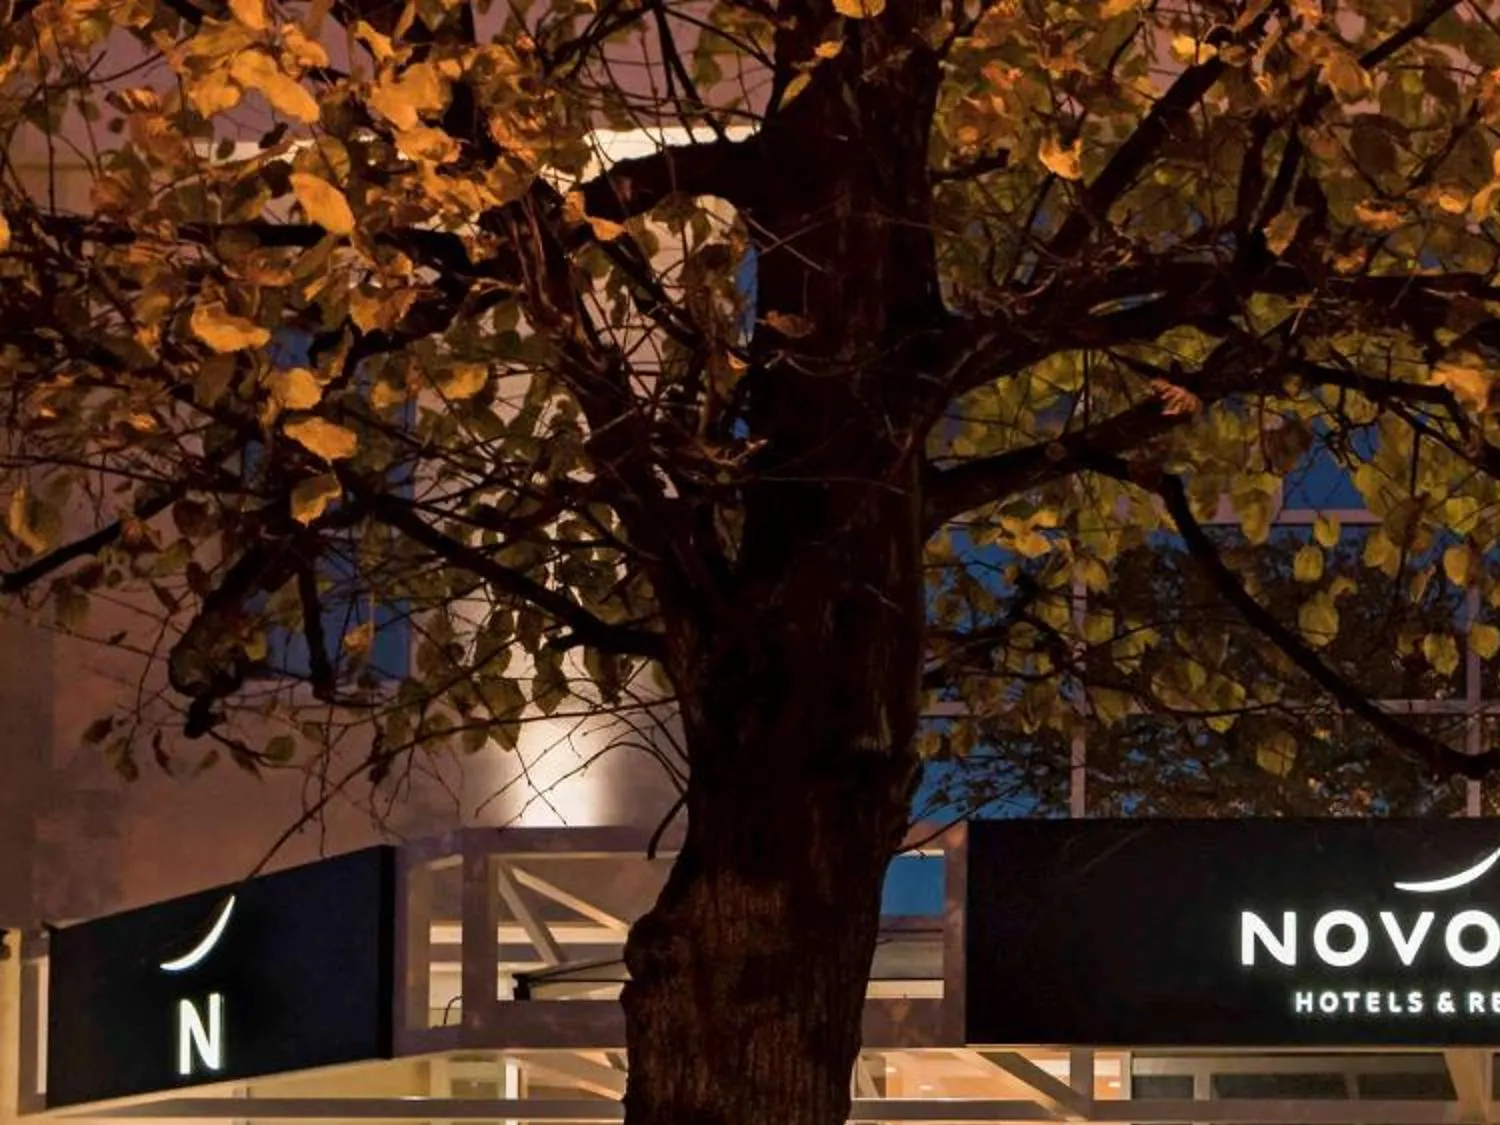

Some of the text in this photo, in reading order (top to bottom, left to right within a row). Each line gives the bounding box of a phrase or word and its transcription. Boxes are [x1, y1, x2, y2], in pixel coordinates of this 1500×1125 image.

[1295, 990, 1424, 1014] HOTELS
[1436, 990, 1457, 1014] &
[178, 991, 222, 1076] N
